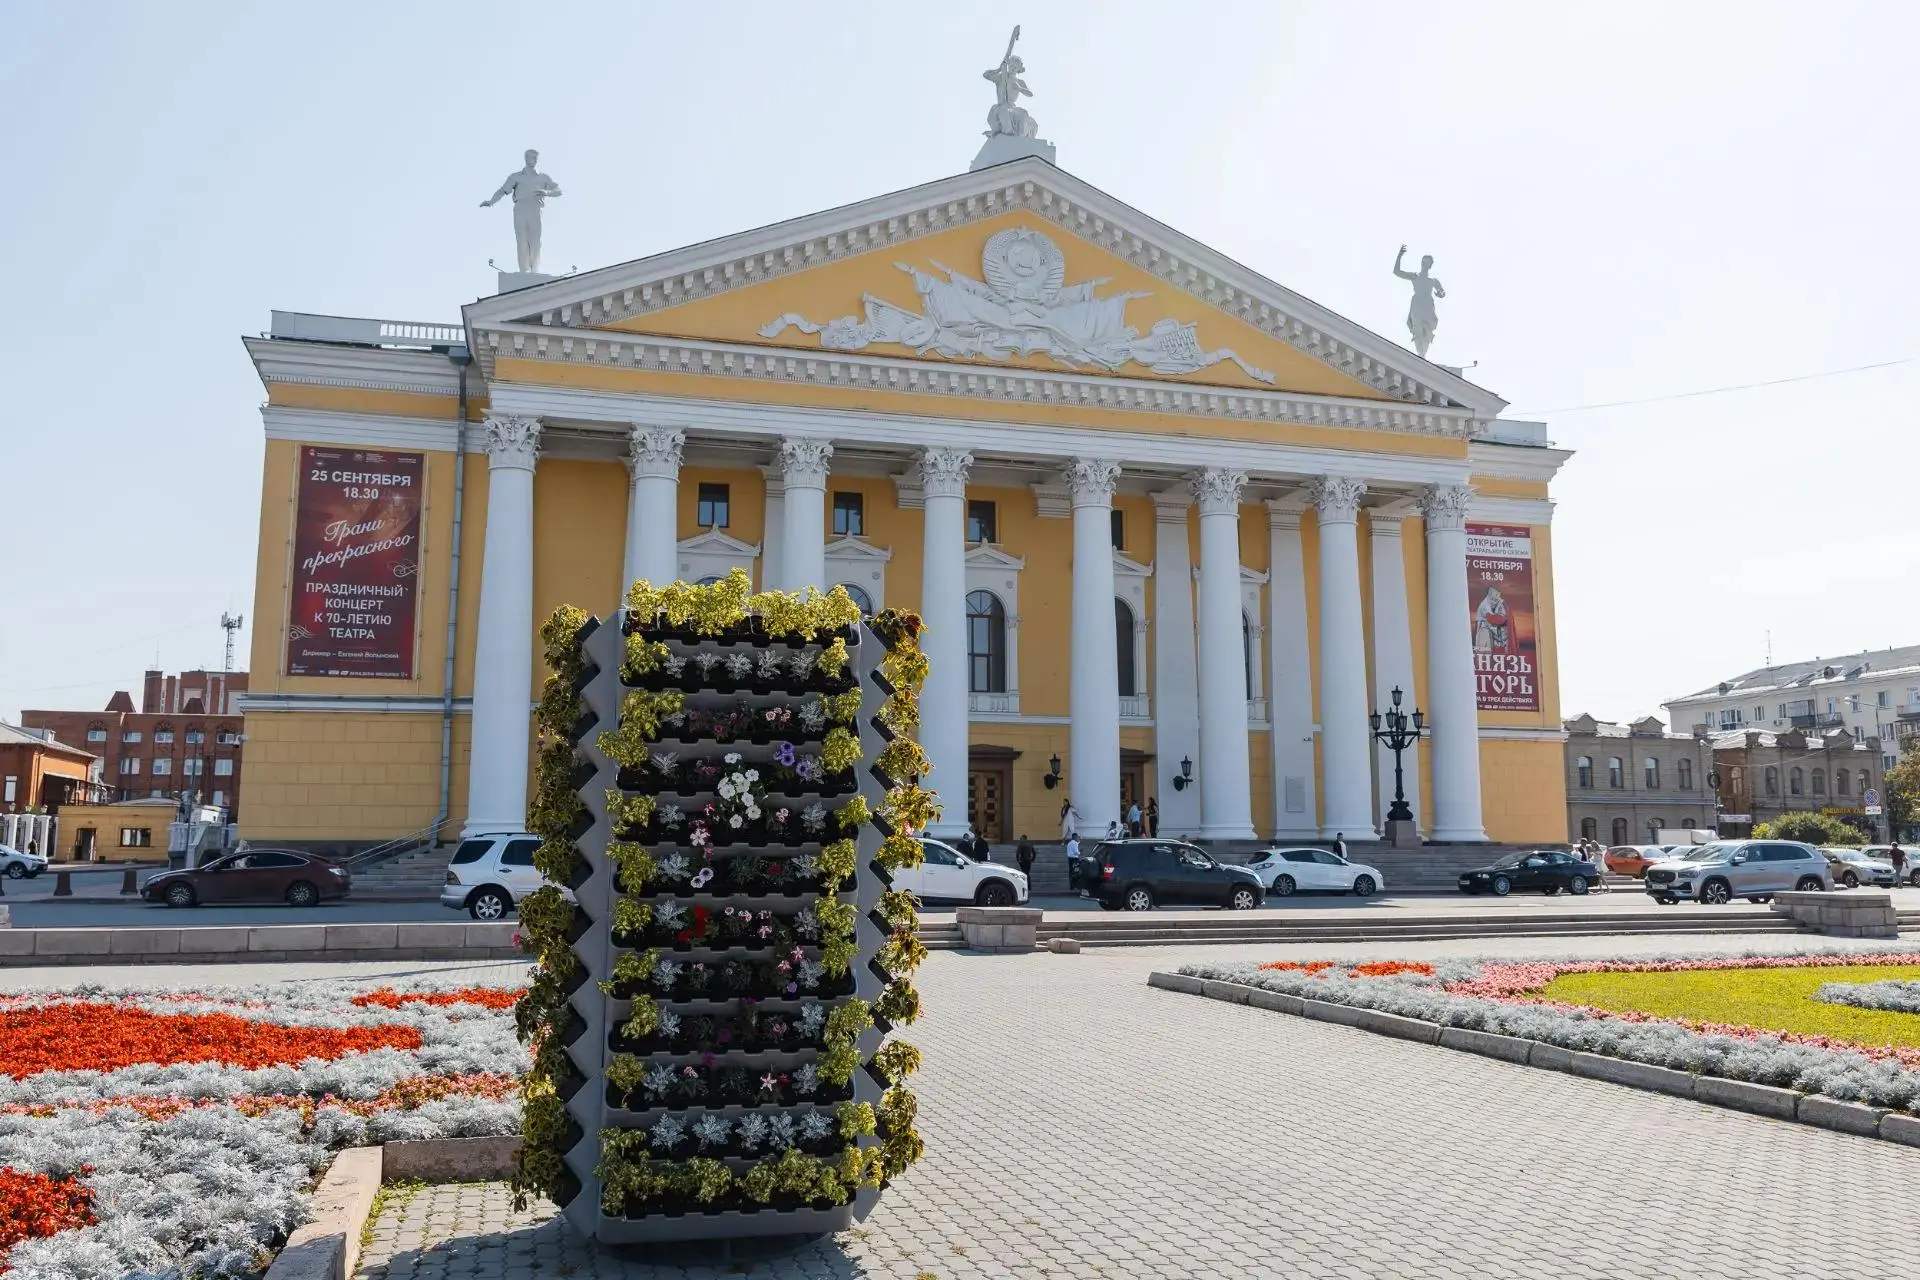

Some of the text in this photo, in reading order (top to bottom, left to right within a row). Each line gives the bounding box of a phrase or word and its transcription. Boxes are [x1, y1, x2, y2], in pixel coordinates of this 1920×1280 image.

[311, 469, 412, 487] 25 СЕНТЯБРЯ
[343, 486, 379, 499] 18.30
[324, 519, 385, 546] Грани
[1467, 537, 1514, 549] ОТКРЫТИЕ
[302, 534, 415, 575] прекрасного
[1472, 559, 1523, 571] СЕНТЯБРЯ
[1481, 571, 1504, 582] 18.30
[306, 582, 404, 597] ПРАЗДНИЧНЫЙ
[325, 598, 384, 611] КОНЦЕРТ
[314, 612, 392, 625] К 70-ЛЕТИЮ
[328, 627, 376, 640] ТЕАТРА
